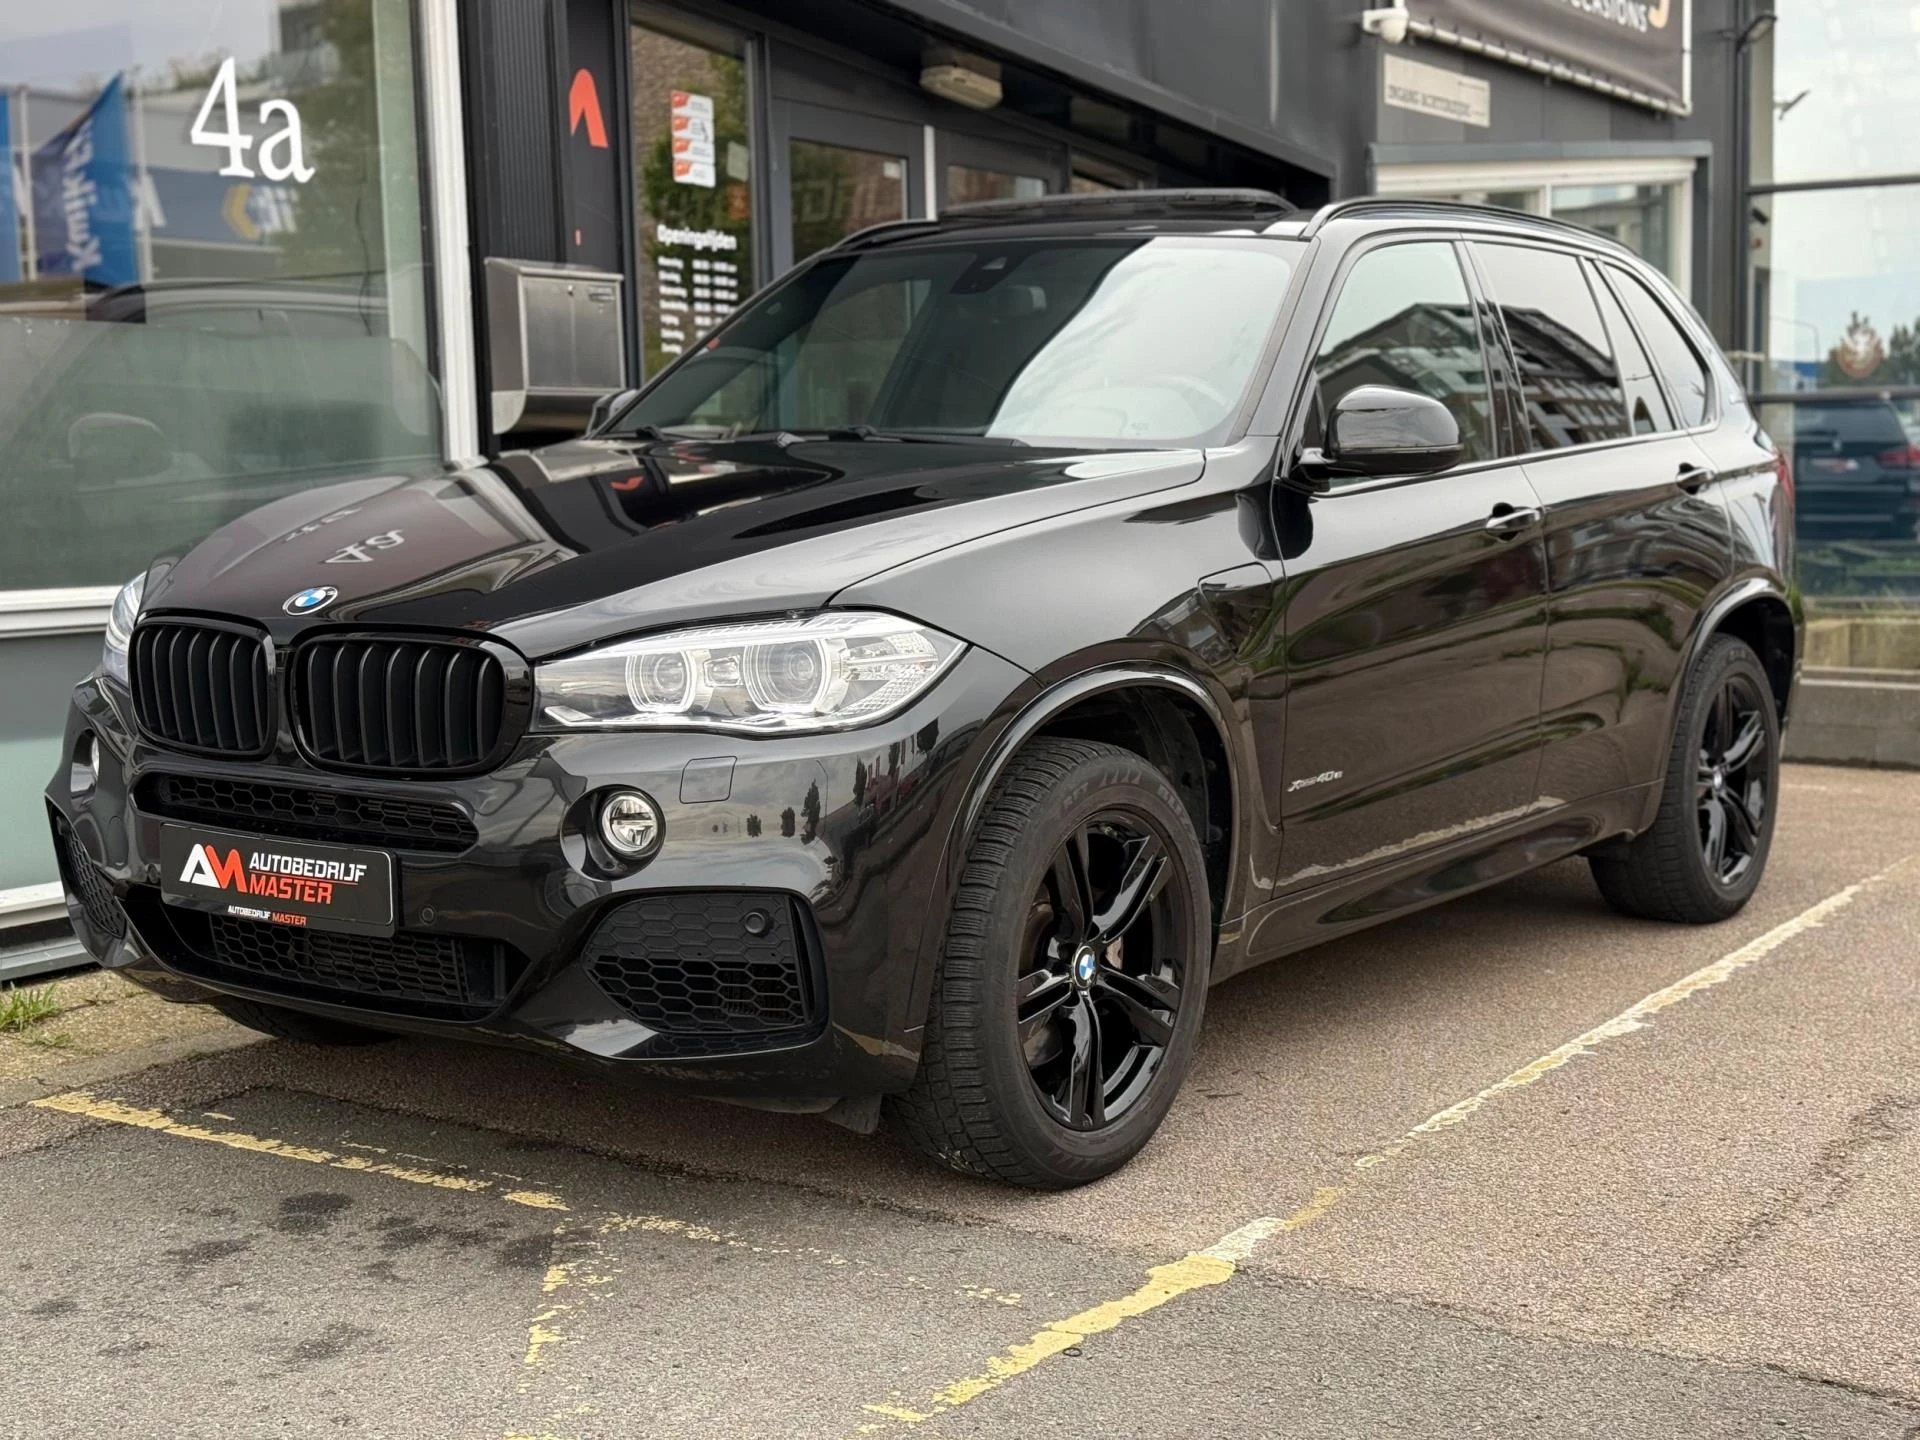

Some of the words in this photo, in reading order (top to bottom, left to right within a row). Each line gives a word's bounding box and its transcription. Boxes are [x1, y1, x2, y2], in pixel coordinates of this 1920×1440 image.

[190, 56, 316, 183] 4a
[249, 852, 367, 882] AUTOBEDRIJF
[249, 874, 333, 905] MASTER
[227, 905, 271, 920] AUTOBEDRIJF
[272, 912, 307, 926] MASTER
